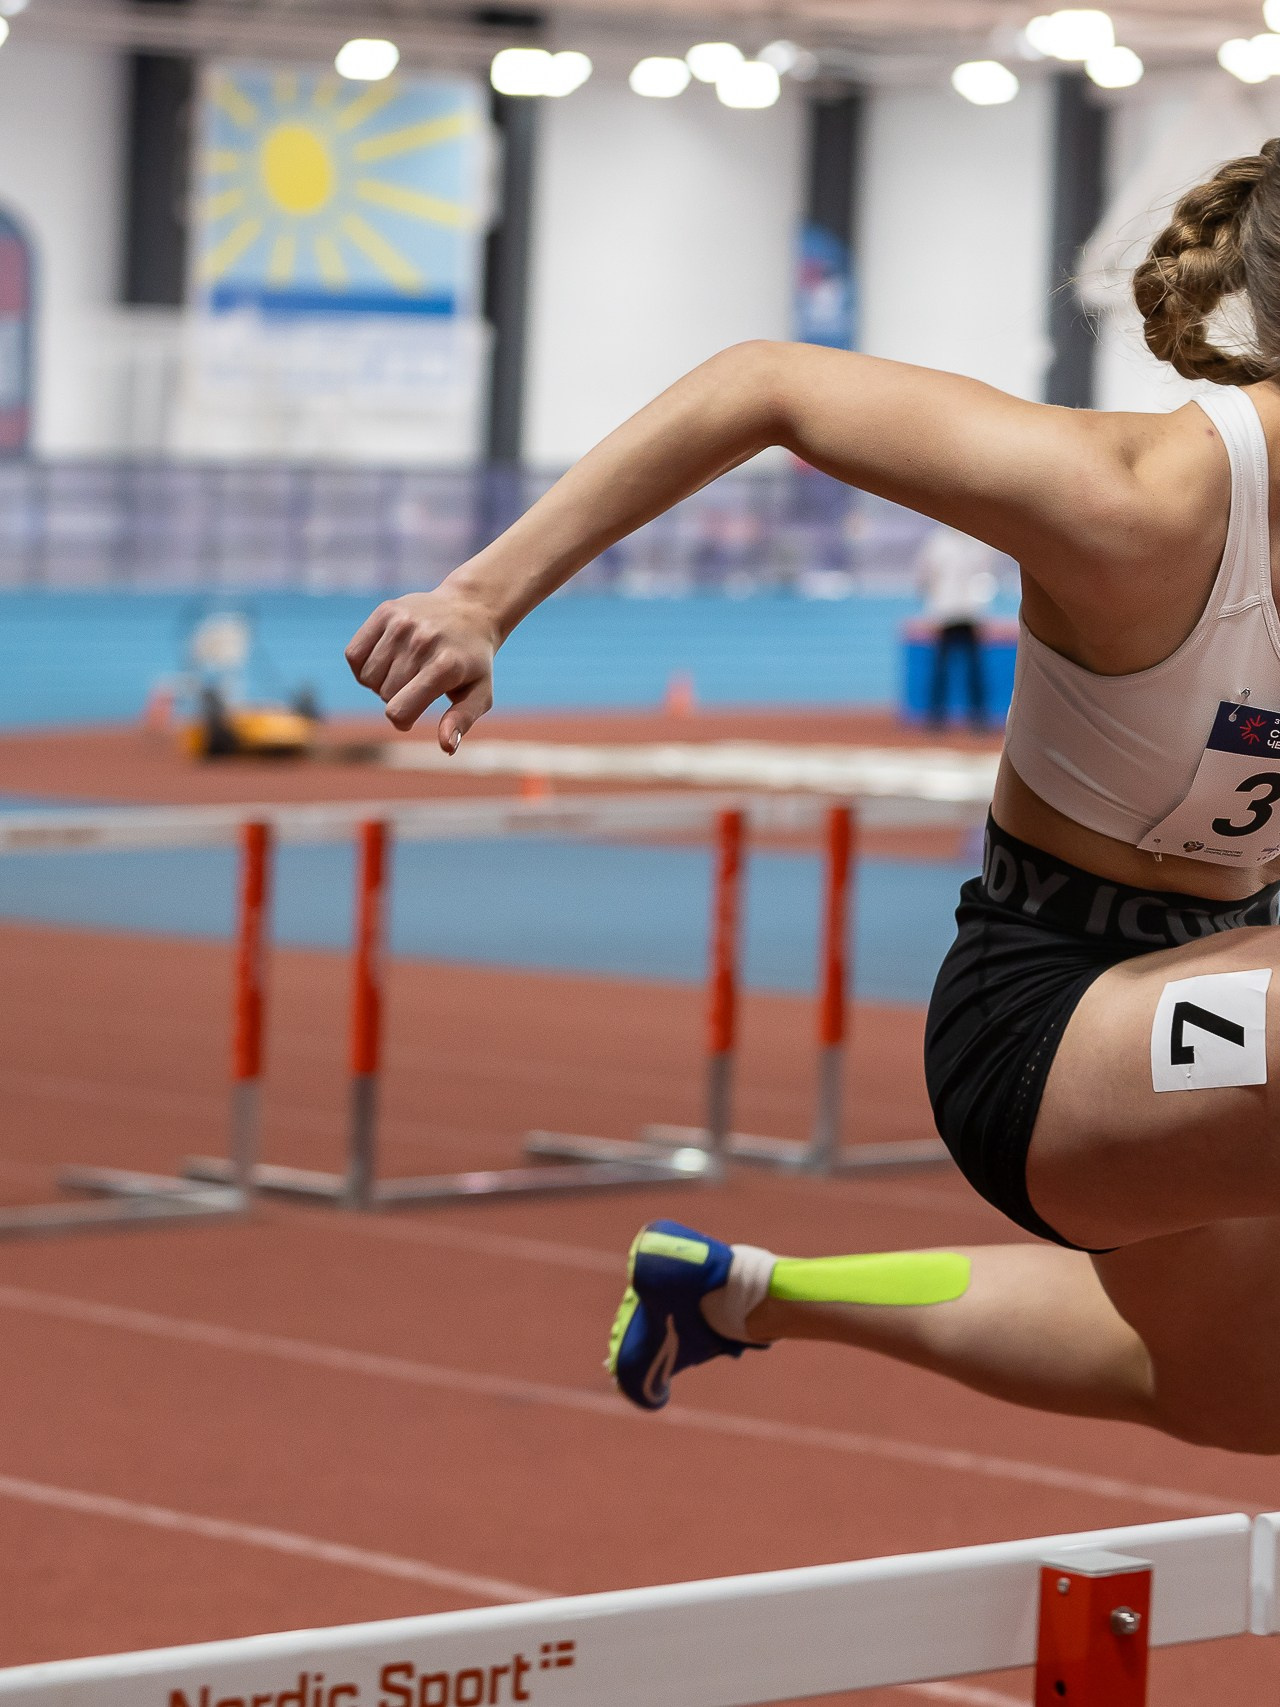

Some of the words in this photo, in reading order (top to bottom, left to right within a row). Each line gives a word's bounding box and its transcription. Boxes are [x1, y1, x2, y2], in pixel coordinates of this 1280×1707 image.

[1170, 1001, 1245, 1065] 7
[169, 1672, 360, 1707] dic
[379, 1653, 531, 1707] Sport
